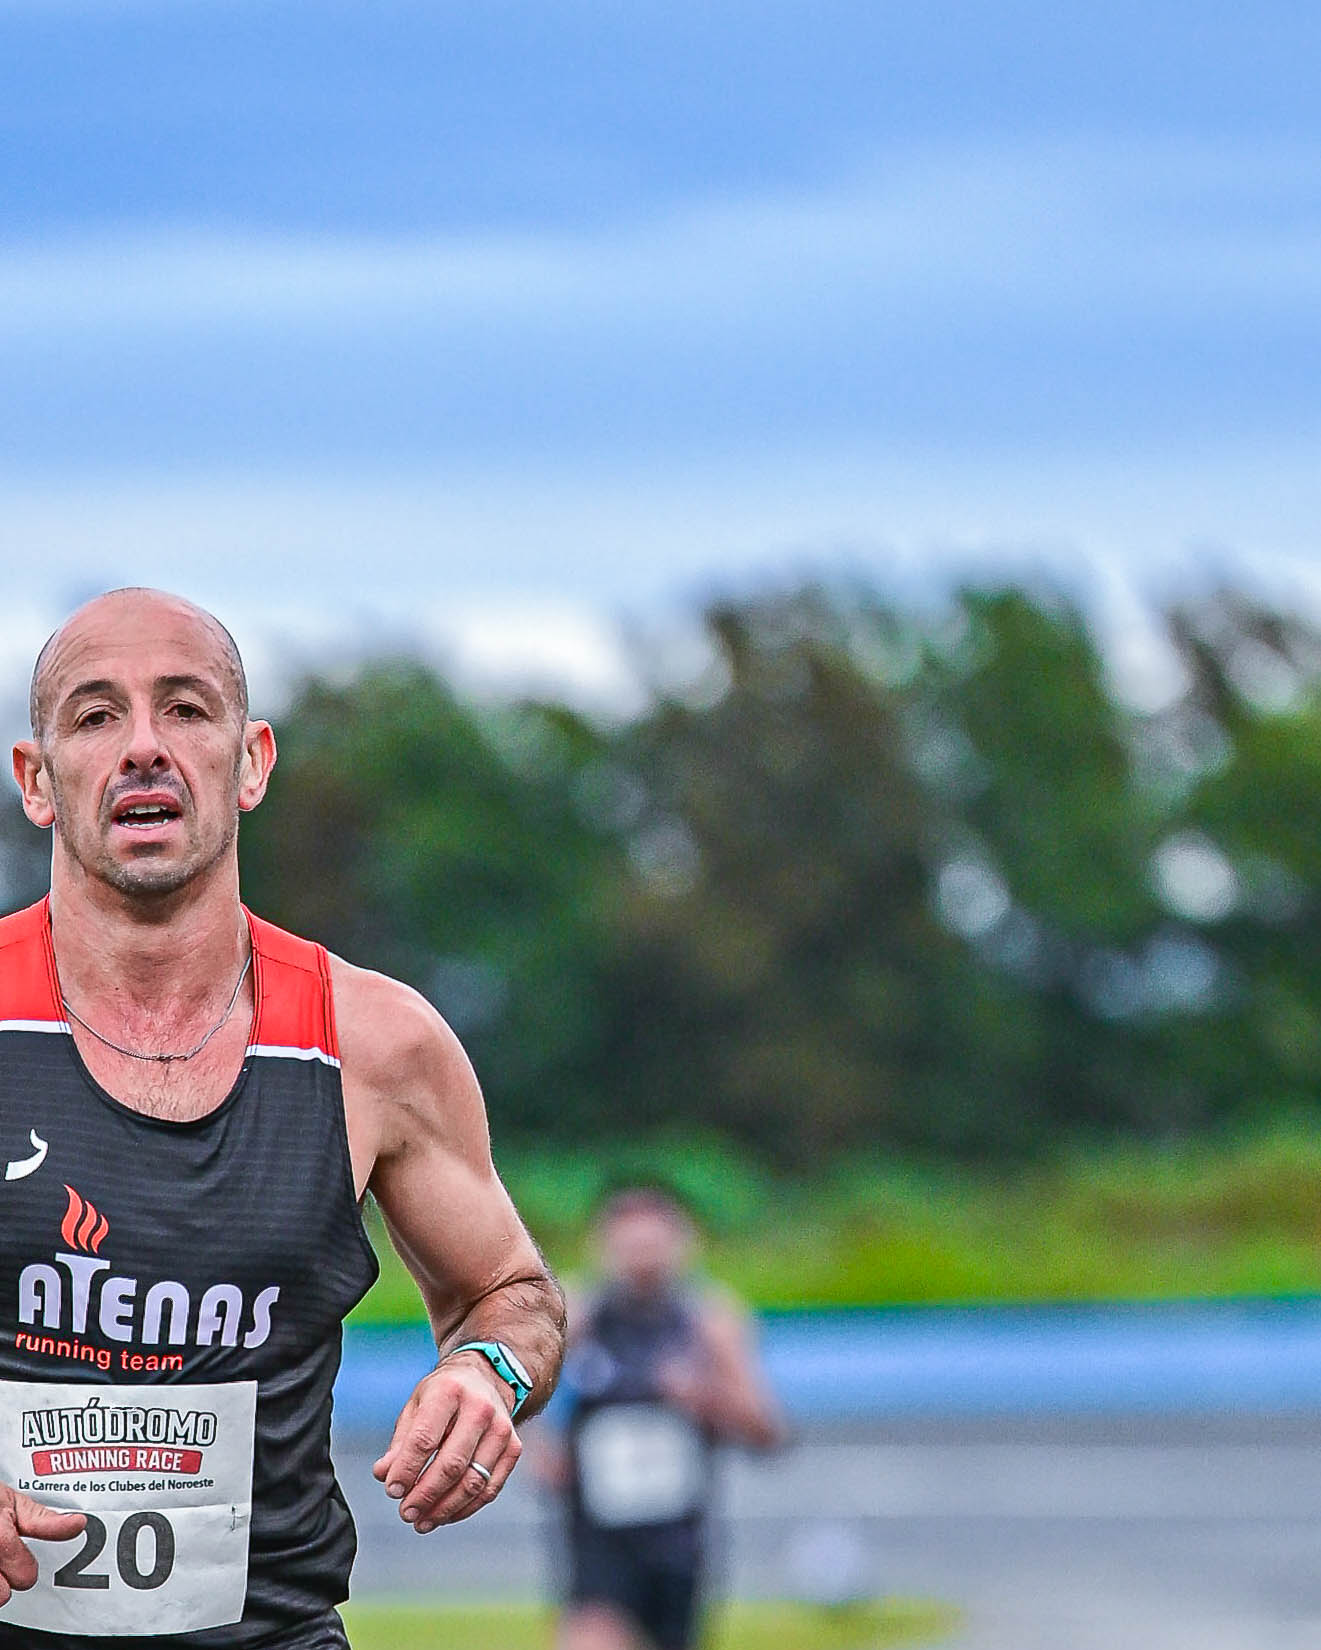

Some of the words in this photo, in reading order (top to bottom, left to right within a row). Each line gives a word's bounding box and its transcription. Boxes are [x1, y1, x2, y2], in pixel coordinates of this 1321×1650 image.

[18, 1252, 280, 1349] ATENAS
[15, 1331, 112, 1371] running
[120, 1349, 183, 1371] team
[22, 1397, 217, 1447] AUTÓDROMO
[49, 1449, 130, 1472] RUNNING
[135, 1449, 184, 1471] RACE
[18, 1478, 30, 1490] La
[32, 1479, 70, 1491] Carrera
[73, 1481, 87, 1492] de
[90, 1481, 106, 1492] los
[108, 1480, 146, 1492] Clubes
[148, 1480, 165, 1491] del
[168, 1478, 214, 1490] Noroeste
[53, 1511, 175, 1590] 20
